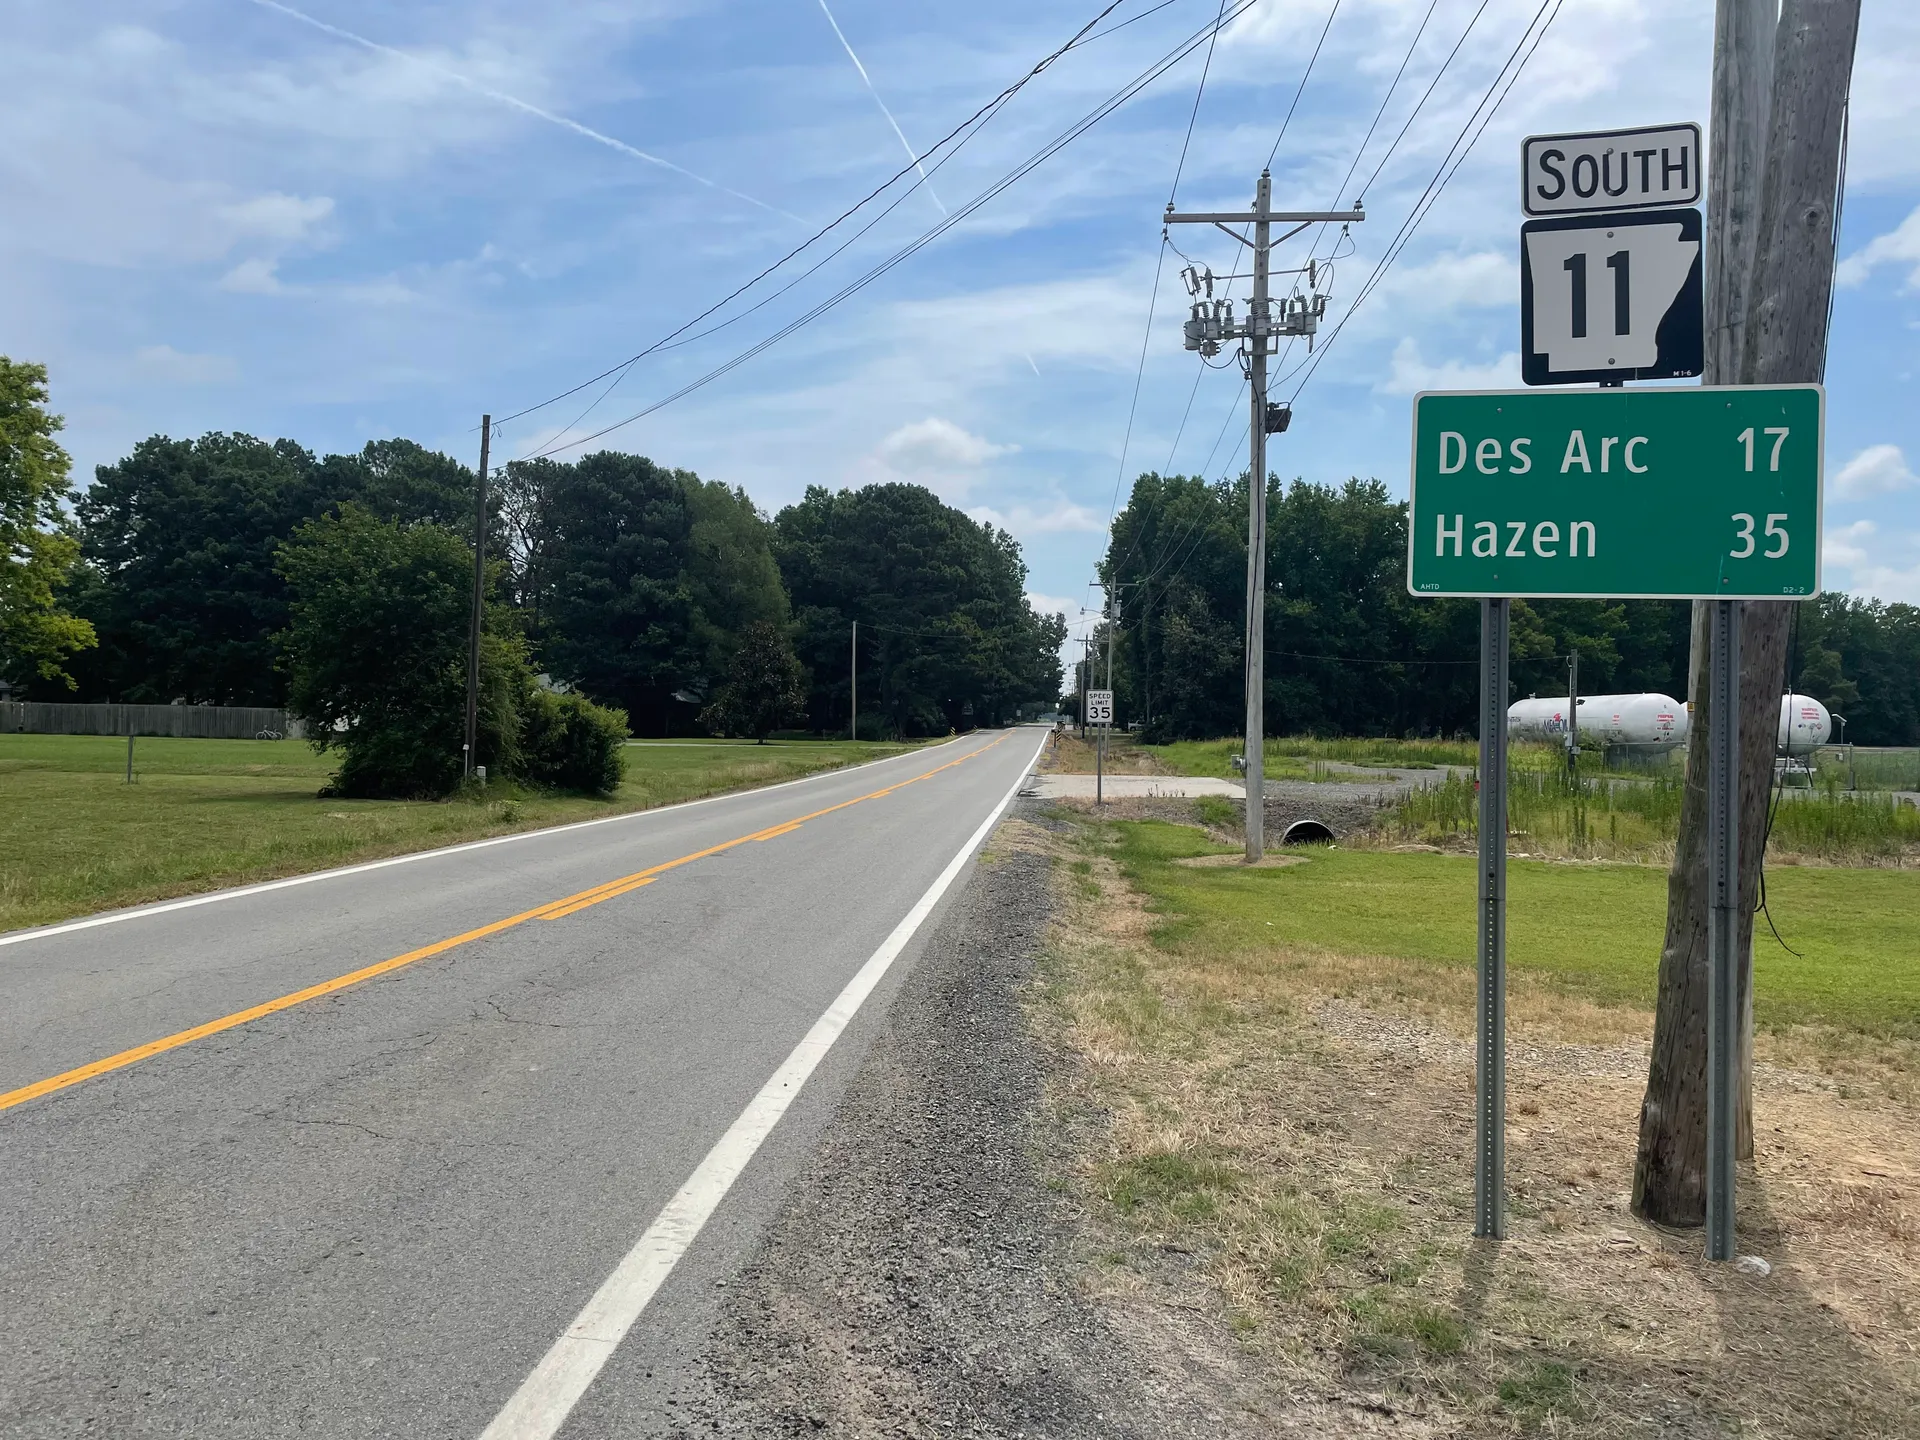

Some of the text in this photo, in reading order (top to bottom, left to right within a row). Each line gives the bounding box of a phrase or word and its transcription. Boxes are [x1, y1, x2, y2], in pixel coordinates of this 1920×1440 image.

[1537, 146, 1688, 200] SOUTH
[1564, 250, 1630, 338] 11
[1439, 427, 1790, 475] Des Arc 17
[1436, 512, 1790, 558] Hazen 35
[1089, 706, 1111, 719] 35
